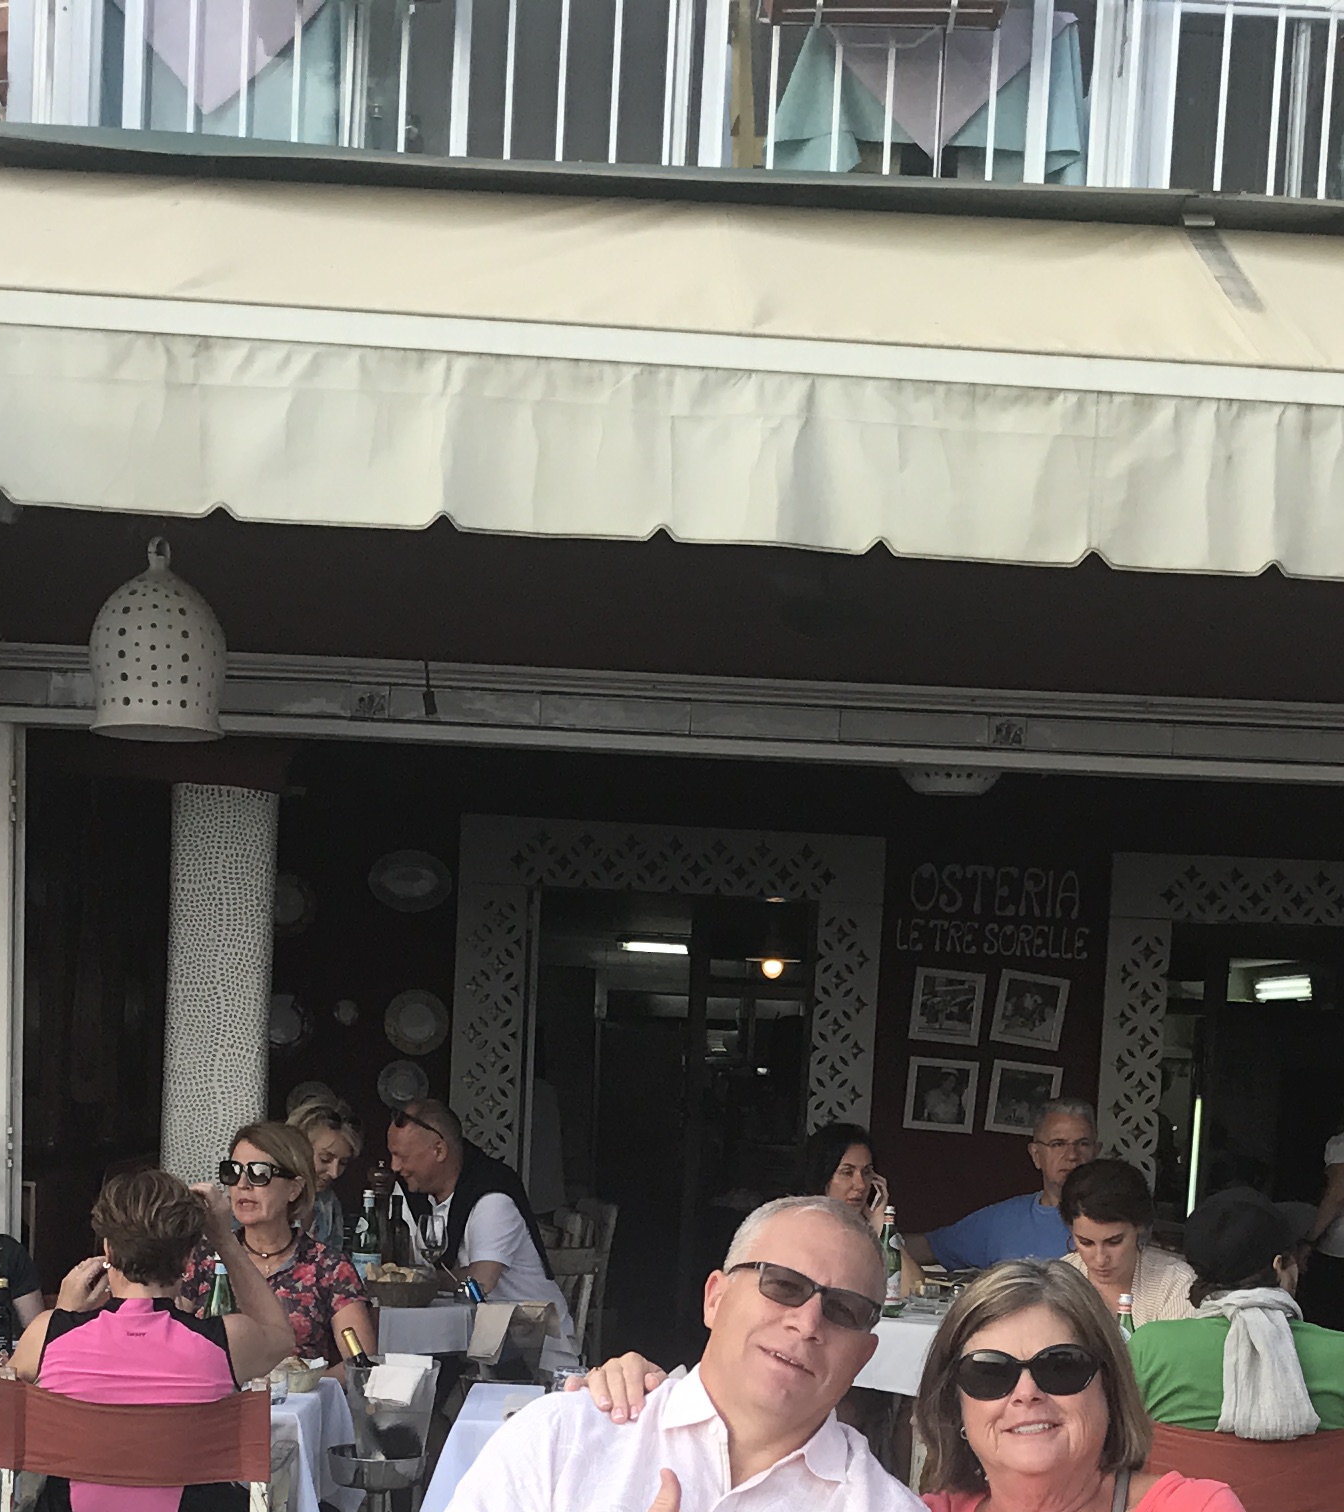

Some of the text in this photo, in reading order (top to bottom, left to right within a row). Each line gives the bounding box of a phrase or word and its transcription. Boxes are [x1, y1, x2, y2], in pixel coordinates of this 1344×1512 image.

[910, 862, 1080, 918] OSTERIA
[897, 918, 1089, 959] LE TRE SORELLE
